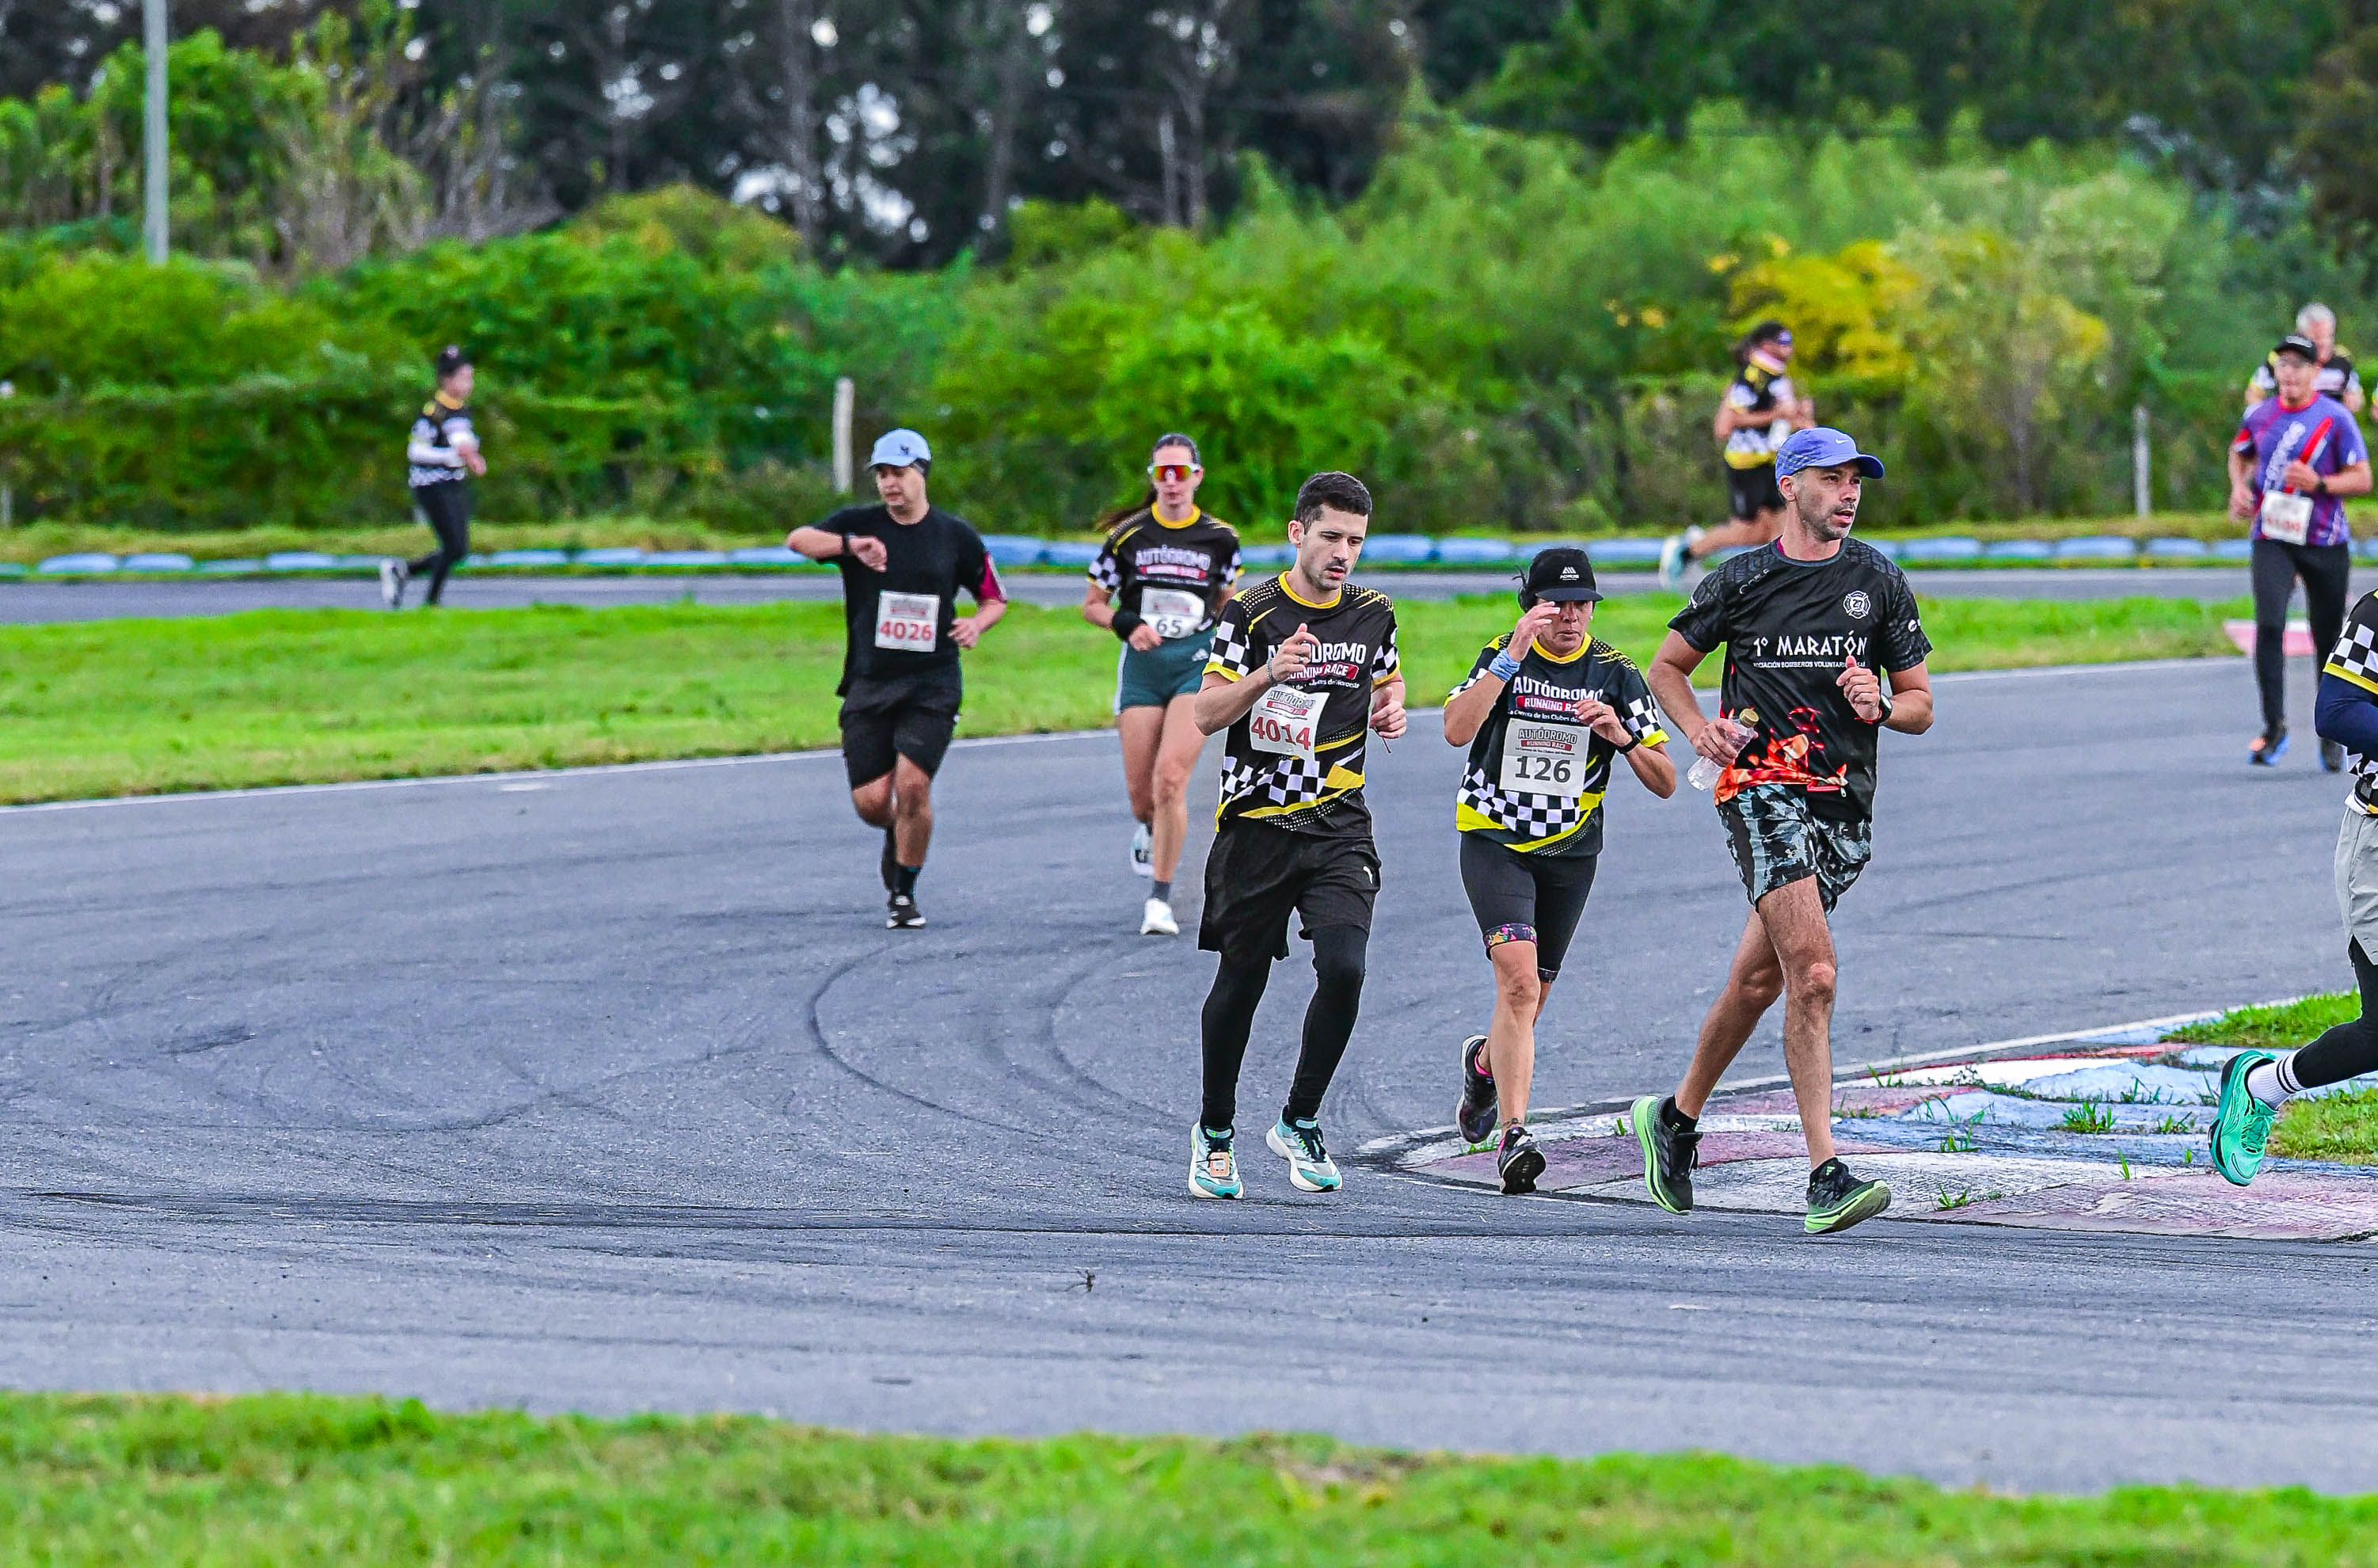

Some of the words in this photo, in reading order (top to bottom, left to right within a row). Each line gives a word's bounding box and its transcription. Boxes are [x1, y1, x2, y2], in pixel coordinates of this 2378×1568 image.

[880, 620, 933, 641] 4026
[1157, 618, 1181, 634] 65
[1776, 630, 1867, 657] MARATÓN
[1324, 663, 1349, 676] RACE
[1524, 697, 1563, 712] RUNNING
[1251, 716, 1311, 751] 4014
[1518, 726, 1578, 745] AUTÓDROMO
[1515, 755, 1571, 783] 126
